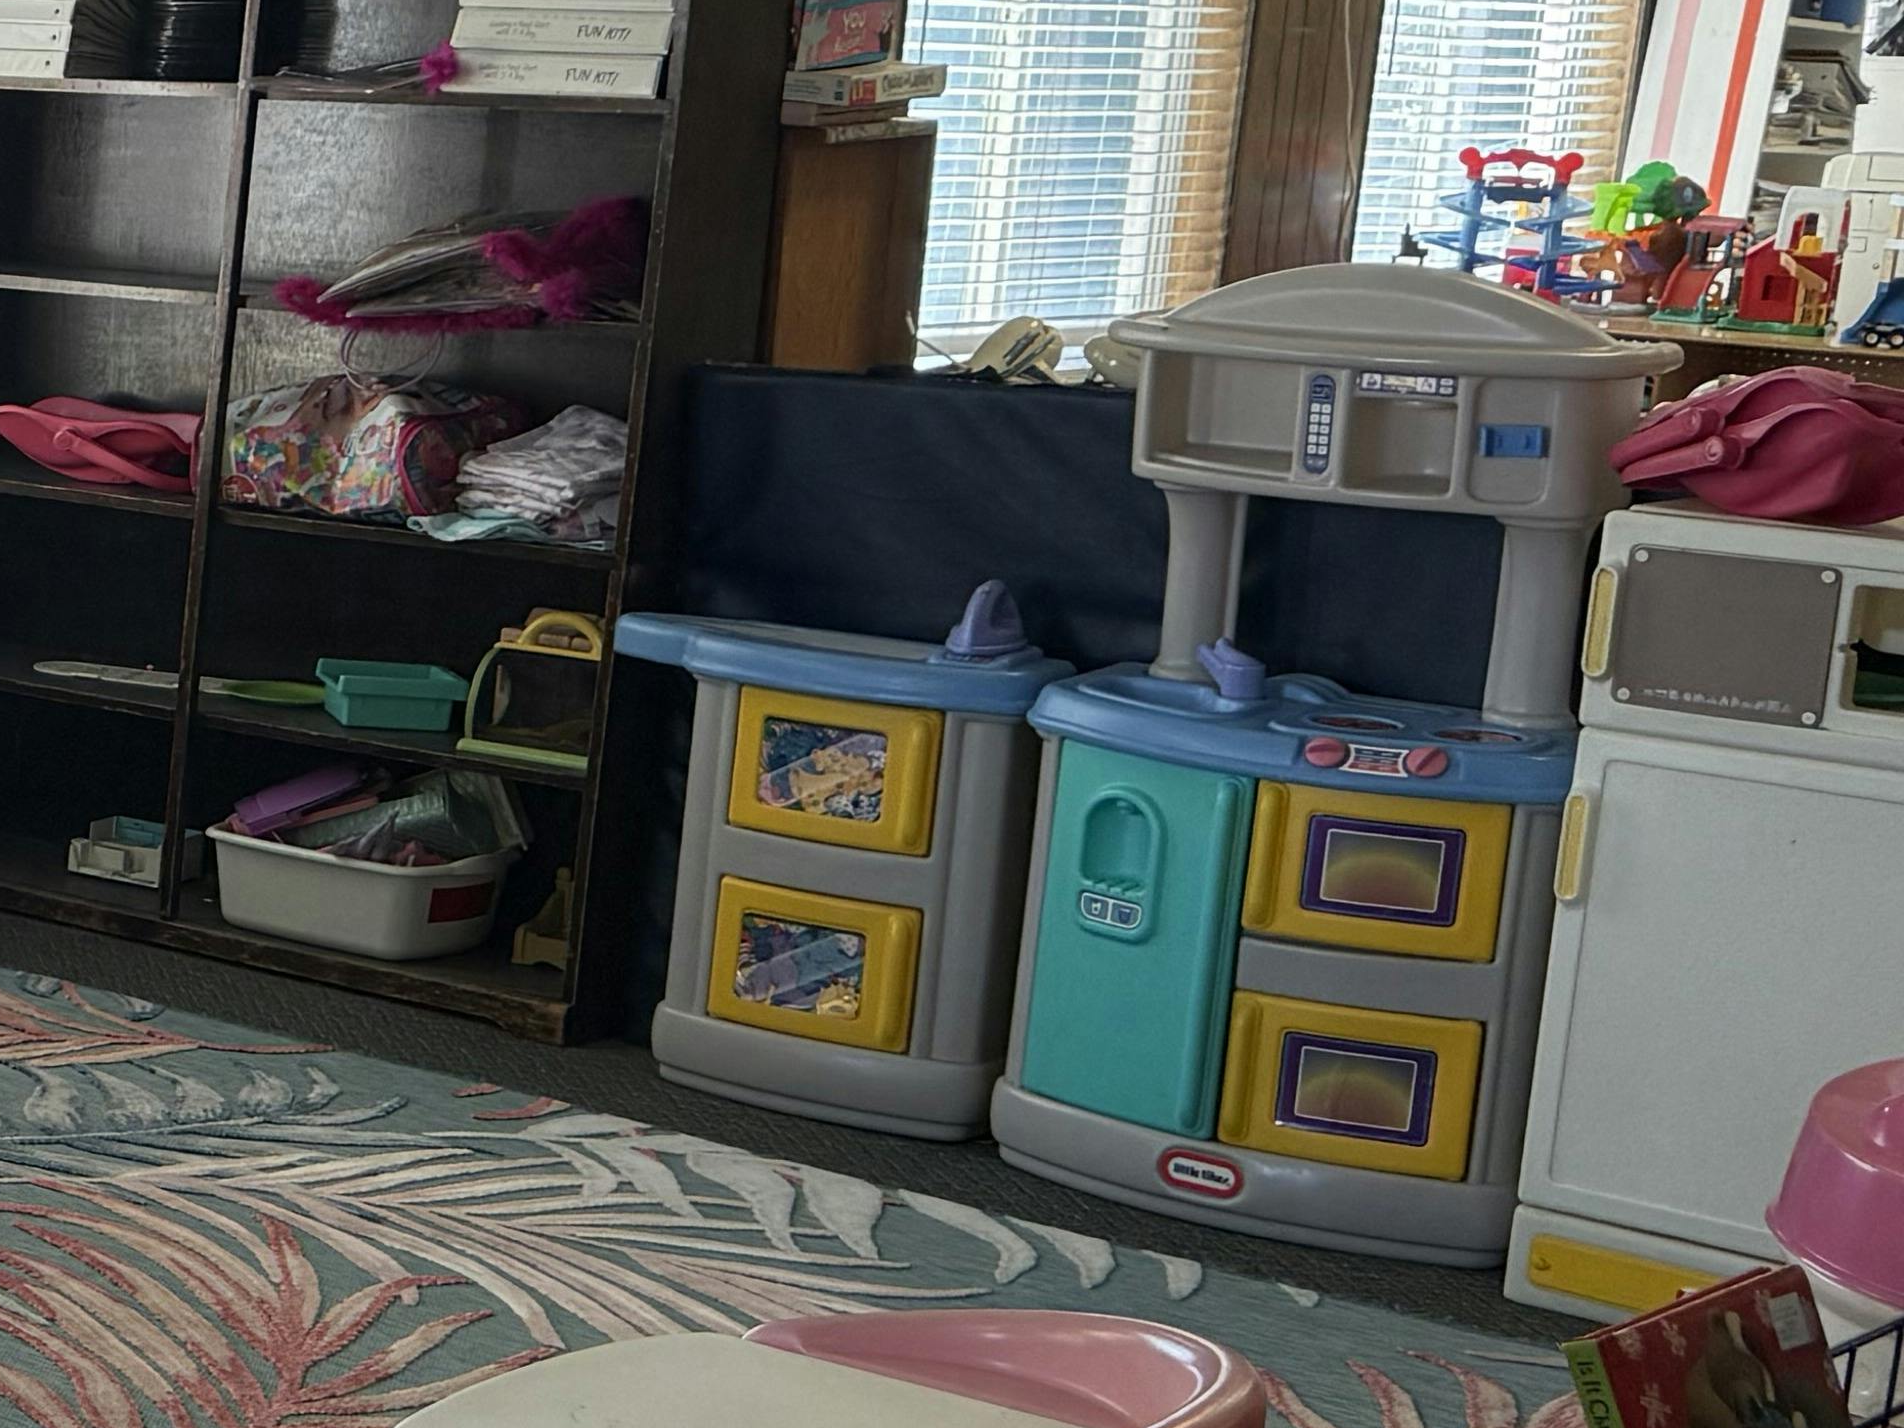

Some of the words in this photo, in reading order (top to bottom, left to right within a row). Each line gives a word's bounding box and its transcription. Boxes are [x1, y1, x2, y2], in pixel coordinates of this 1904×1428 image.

[576, 24, 604, 39] FUN
[565, 67, 592, 83] FUN
[1576, 1360, 1593, 1375] Is
[1582, 1381, 1601, 1393] It
